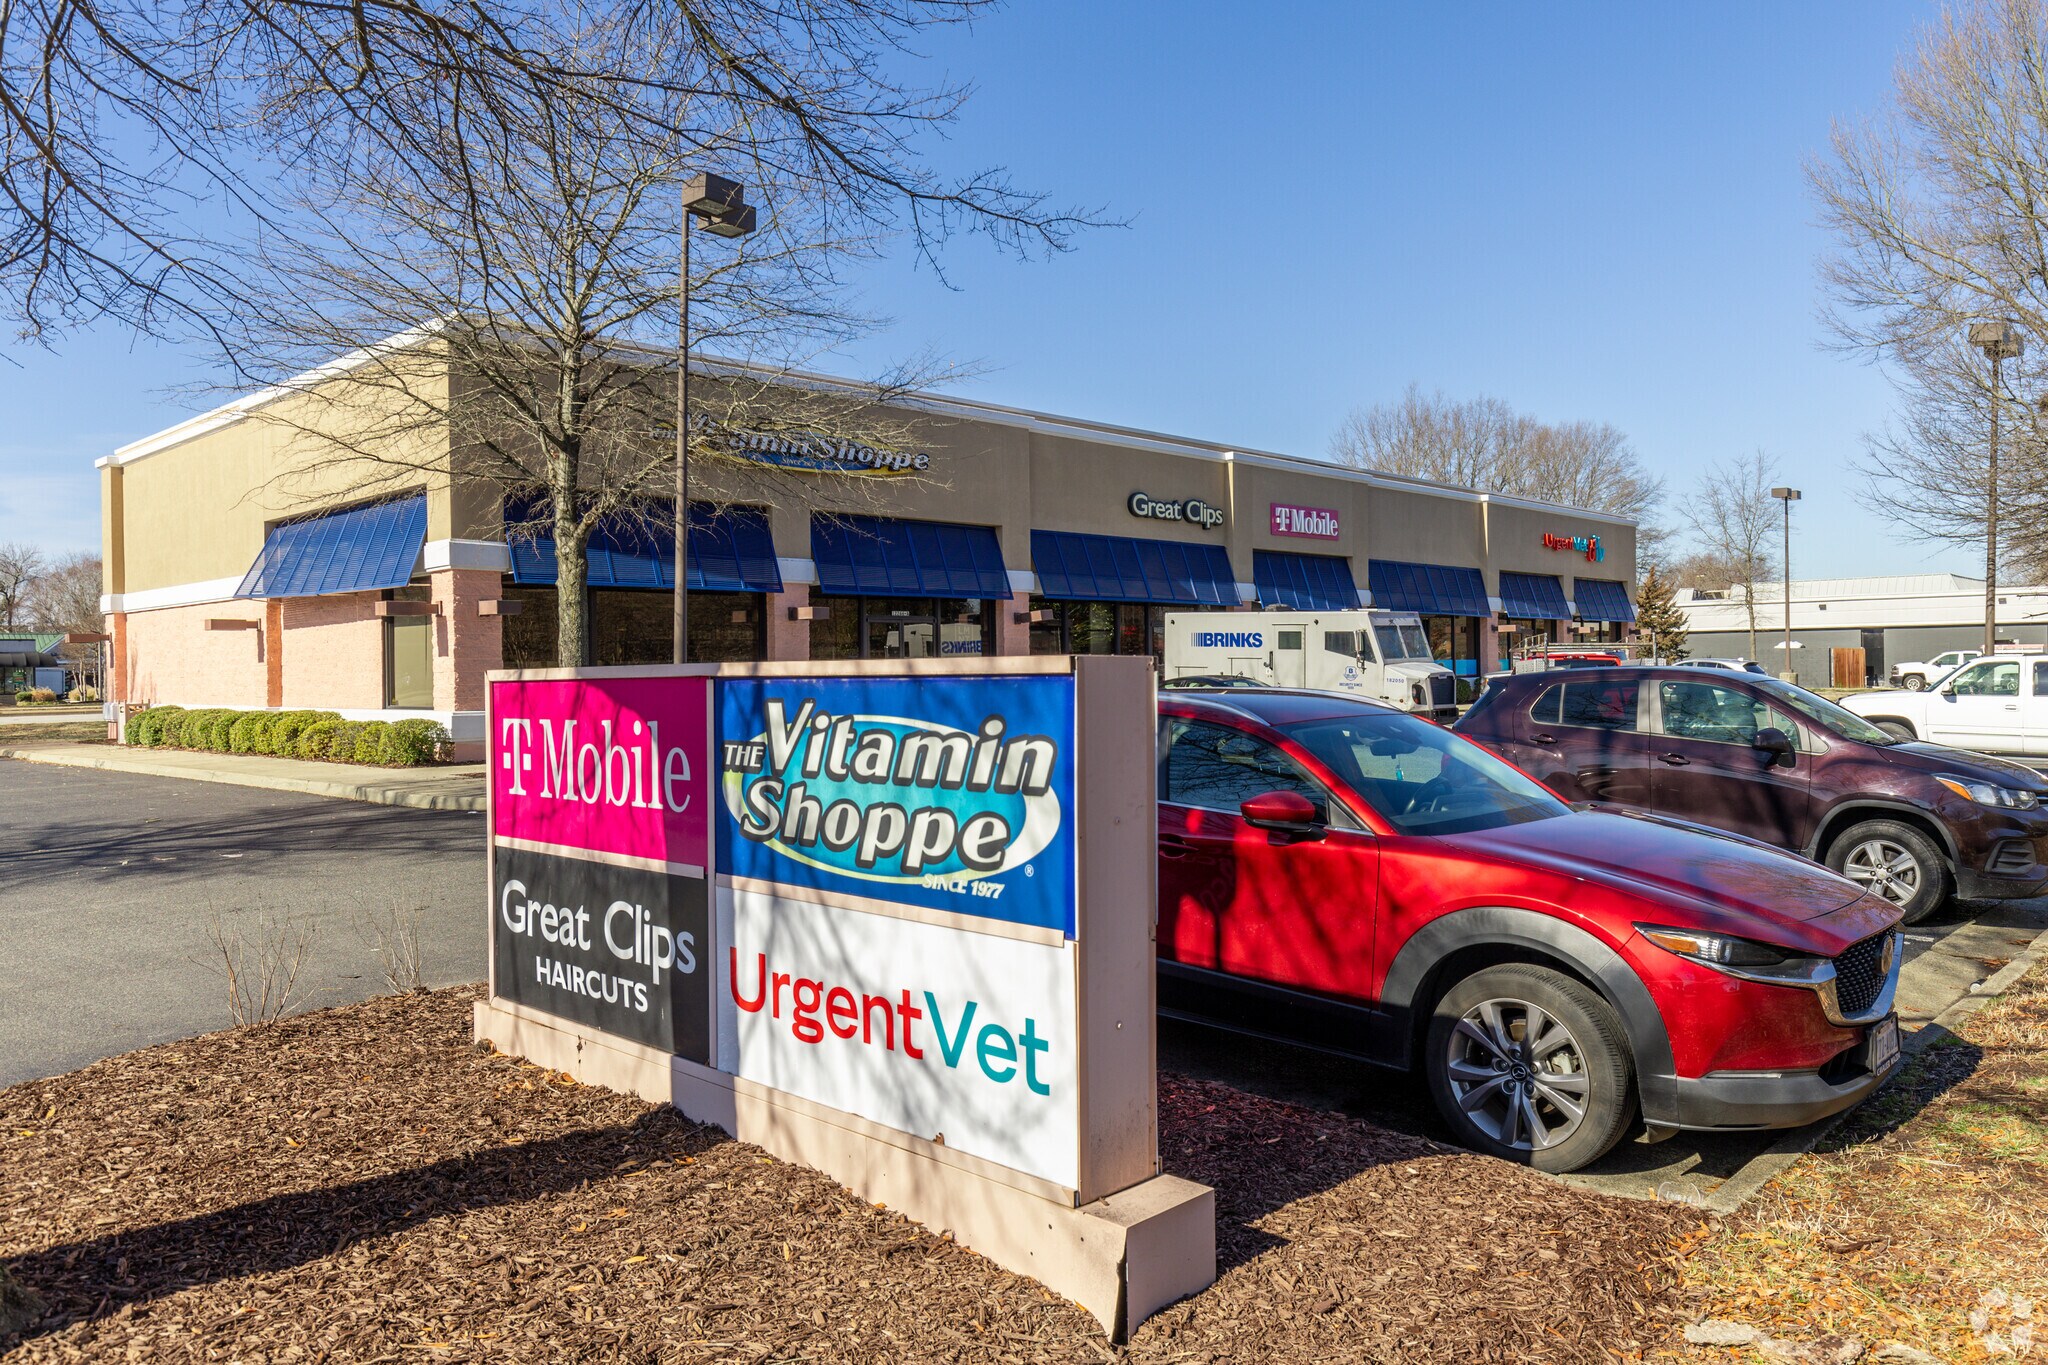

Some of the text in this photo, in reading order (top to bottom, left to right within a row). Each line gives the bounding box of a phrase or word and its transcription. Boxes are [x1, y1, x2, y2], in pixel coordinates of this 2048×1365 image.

[813, 437, 930, 471] Shoppe
[1131, 492, 1224, 529] Great Clips
[1291, 509, 1339, 537] Mobile
[1203, 631, 1263, 649] BRINKS
[539, 718, 691, 813] Mobile
[723, 698, 1057, 796] THE Vitamin
[739, 776, 1021, 874] Shoppe
[922, 873, 1005, 899] SINCE 1977
[502, 879, 696, 985] Great Clips
[535, 955, 649, 1012] HAIRCUTS
[729, 946, 1050, 1096] UrgentVet
